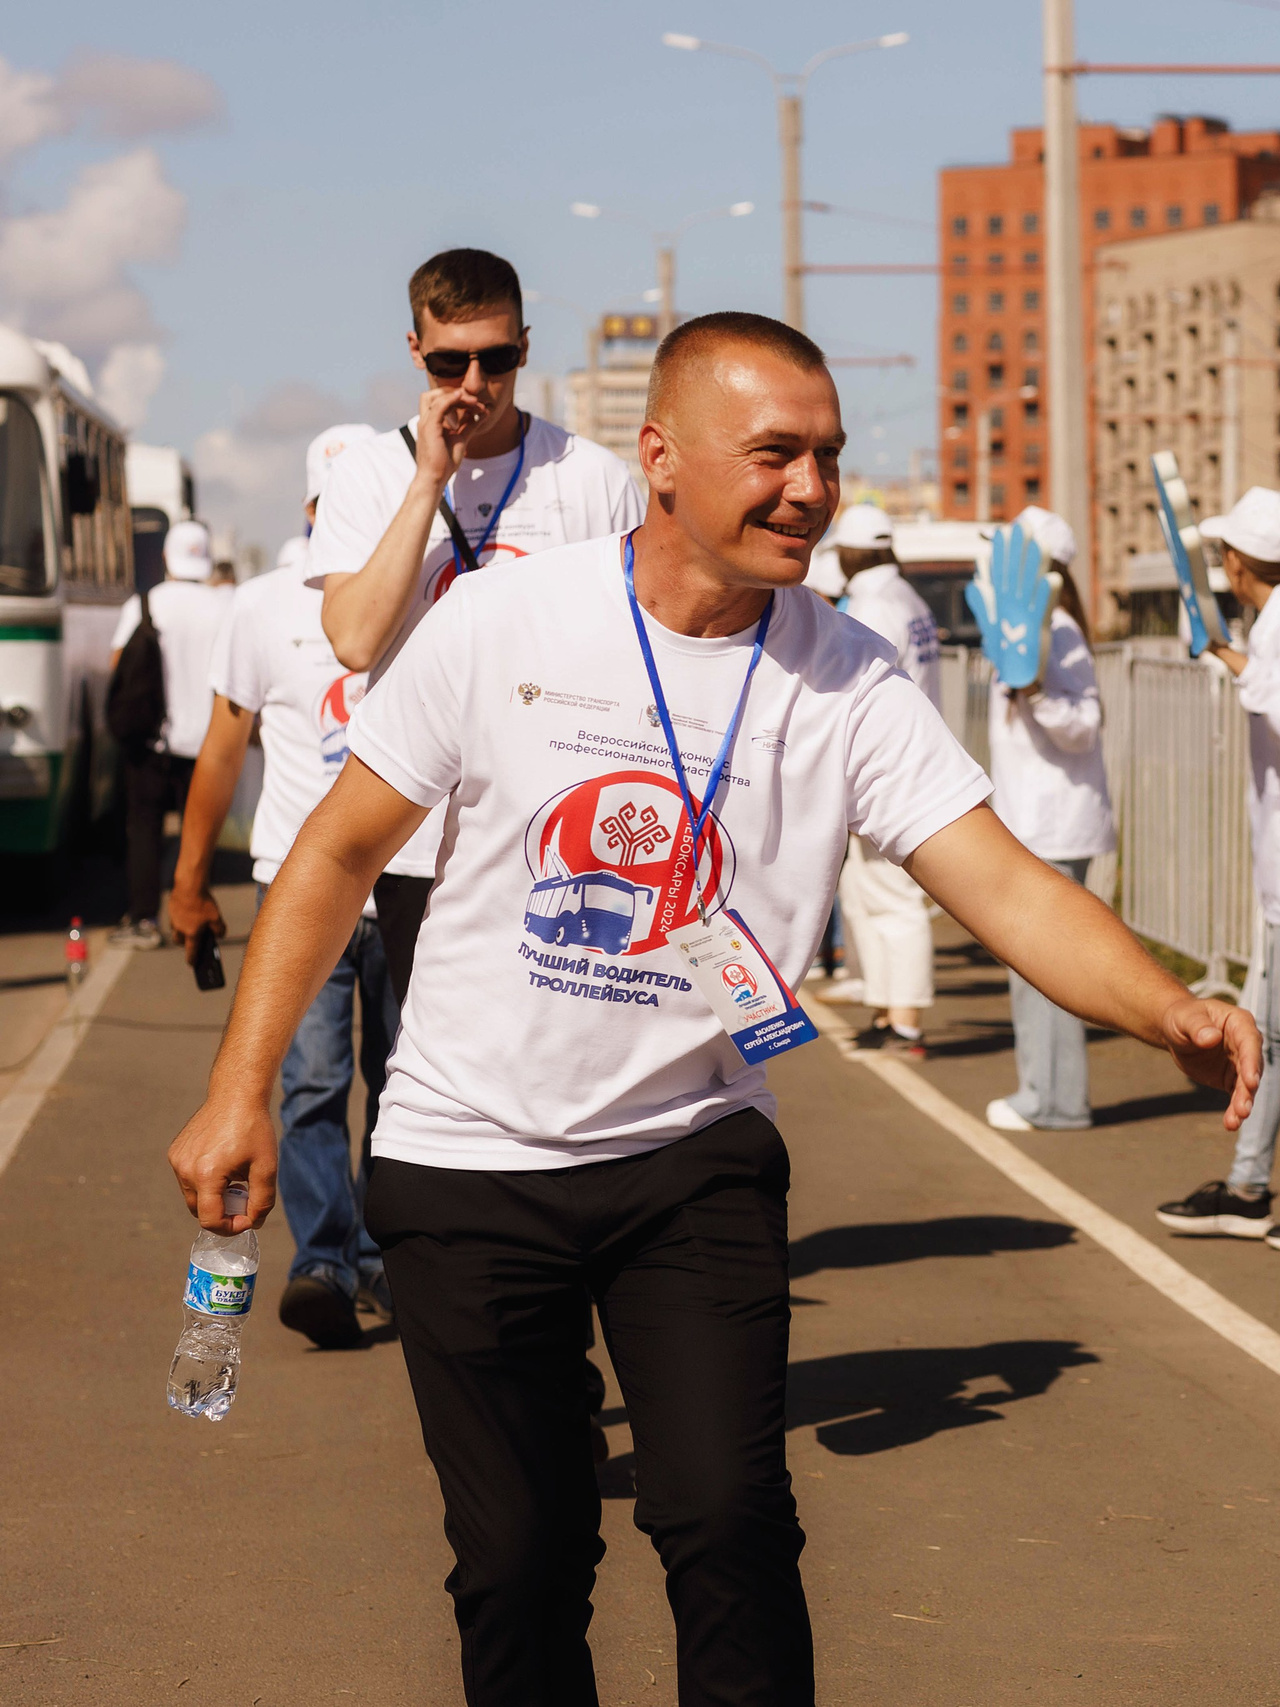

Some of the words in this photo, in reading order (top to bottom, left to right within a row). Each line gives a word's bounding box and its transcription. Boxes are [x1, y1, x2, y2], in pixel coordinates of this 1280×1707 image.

[680, 751, 730, 769] конкус
[682, 765, 751, 787] мастства
[658, 901, 677, 933] 2024
[518, 941, 589, 976] ЛУЧШИЙ
[593, 963, 693, 993] ВОДИТЕЛЬ
[528, 971, 660, 1008] ТРОЛЛЕЙБУСА
[744, 1005, 777, 1022] УЧАСТНИК
[744, 1037, 763, 1050] СЕРГЕЙ
